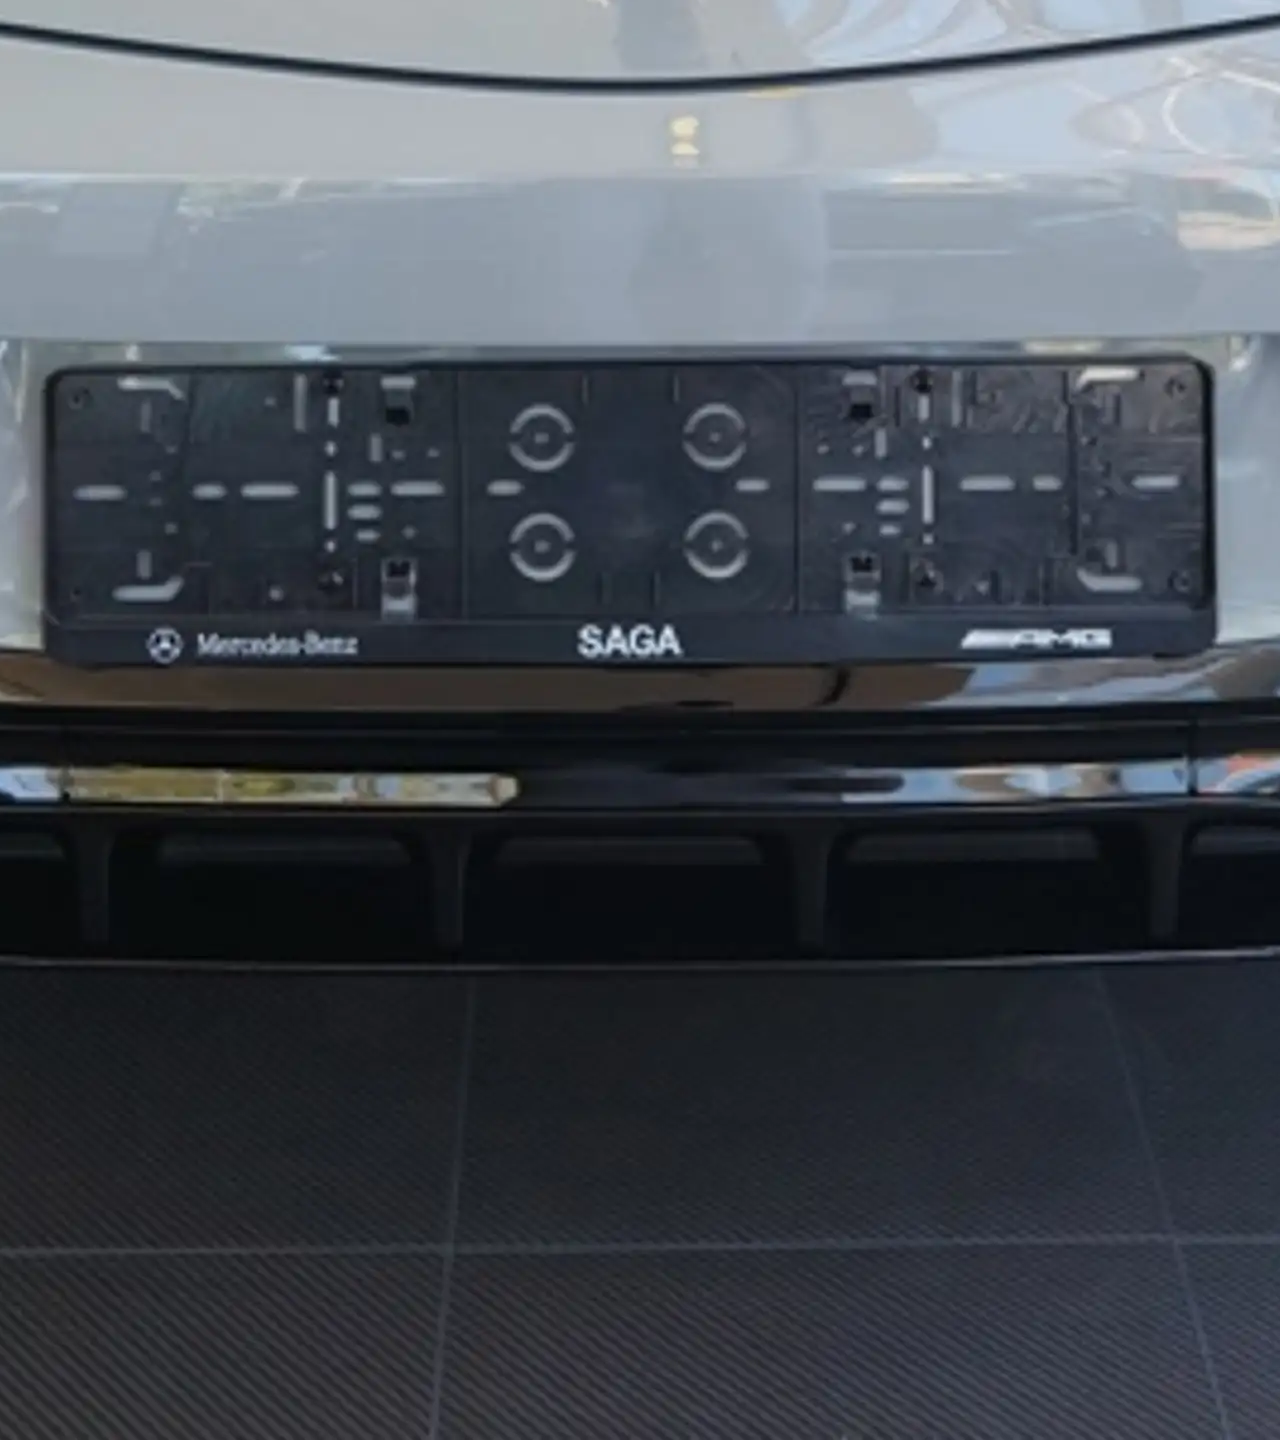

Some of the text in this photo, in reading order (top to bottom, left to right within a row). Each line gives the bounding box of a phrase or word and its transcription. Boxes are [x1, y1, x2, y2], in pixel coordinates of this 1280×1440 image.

[196, 629, 360, 656] Mercedes-Benz
[576, 622, 684, 660] SAGA
[1010, 627, 1113, 651] AMG
